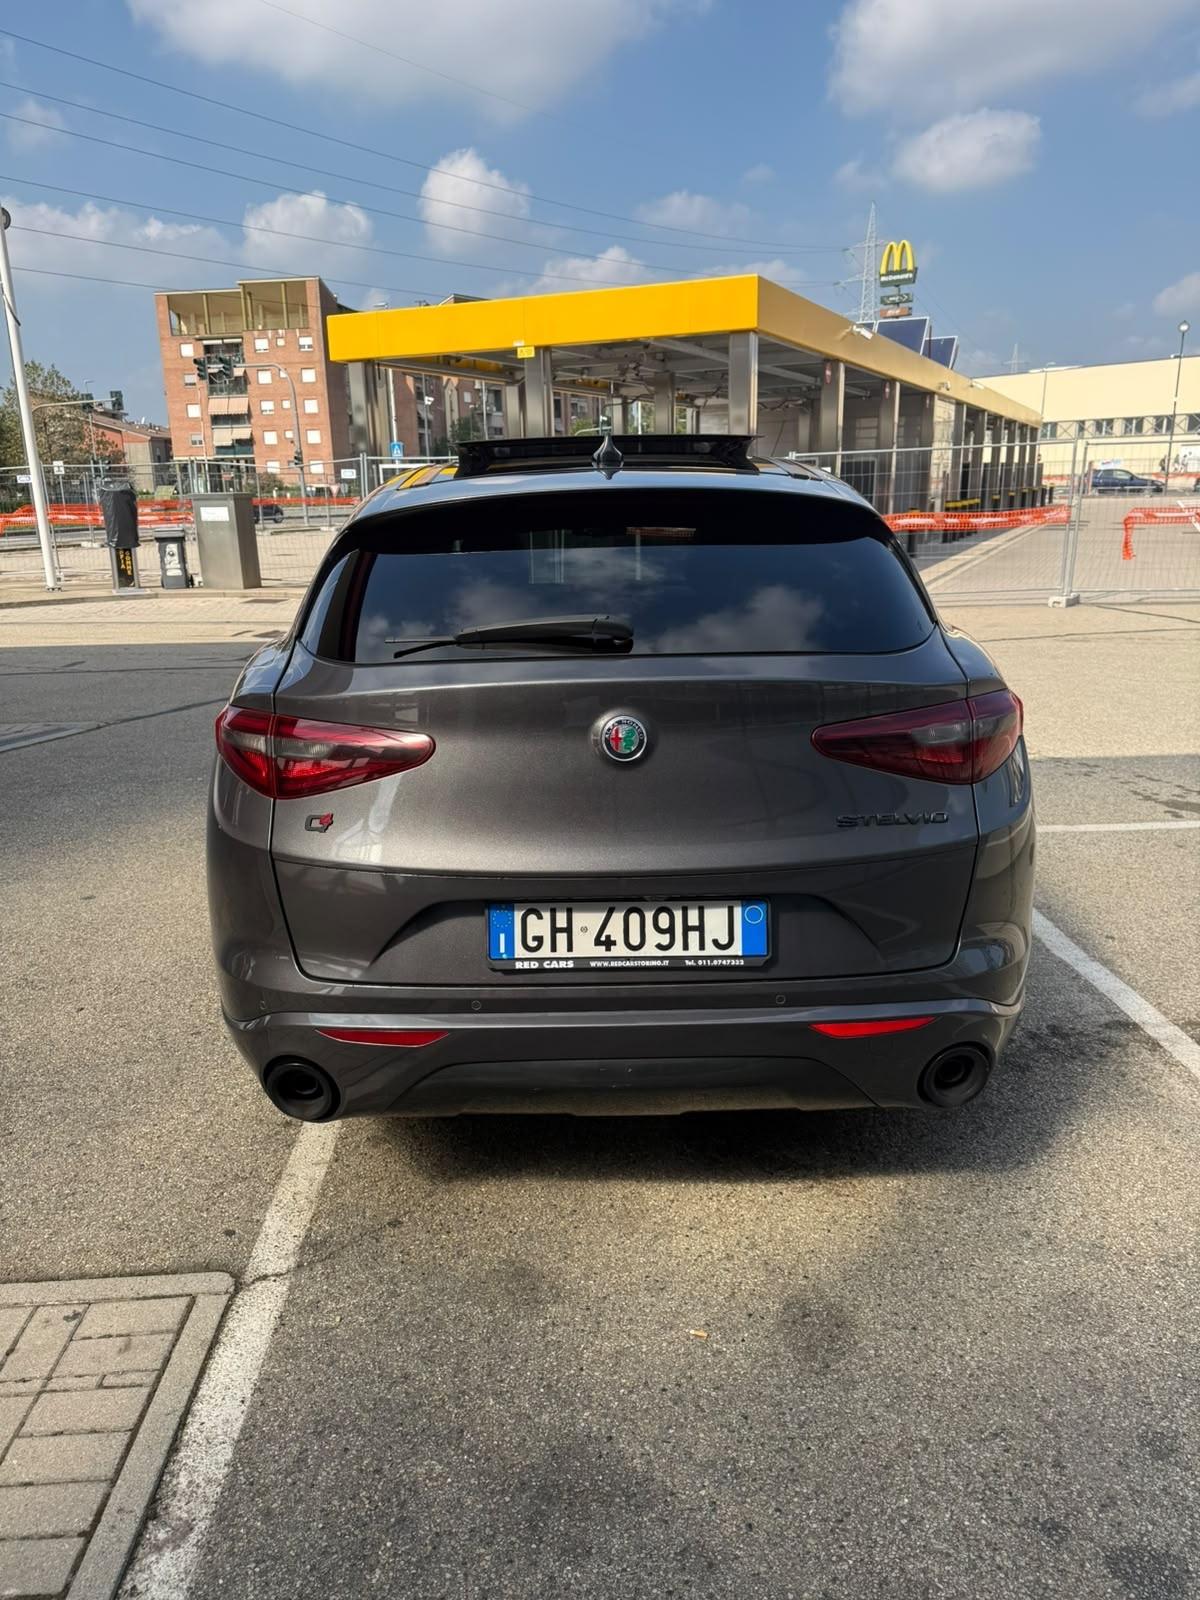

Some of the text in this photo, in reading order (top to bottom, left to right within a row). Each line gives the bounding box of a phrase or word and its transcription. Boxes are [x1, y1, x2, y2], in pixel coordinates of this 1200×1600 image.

[622, 719, 644, 740] ROMEO
[836, 811, 950, 828] STELVIO
[520, 905, 735, 953] GH 409HJ
[515, 960, 575, 969] RED CARS
[589, 960, 670, 968] WWW.REDCARSTORINO.IT
